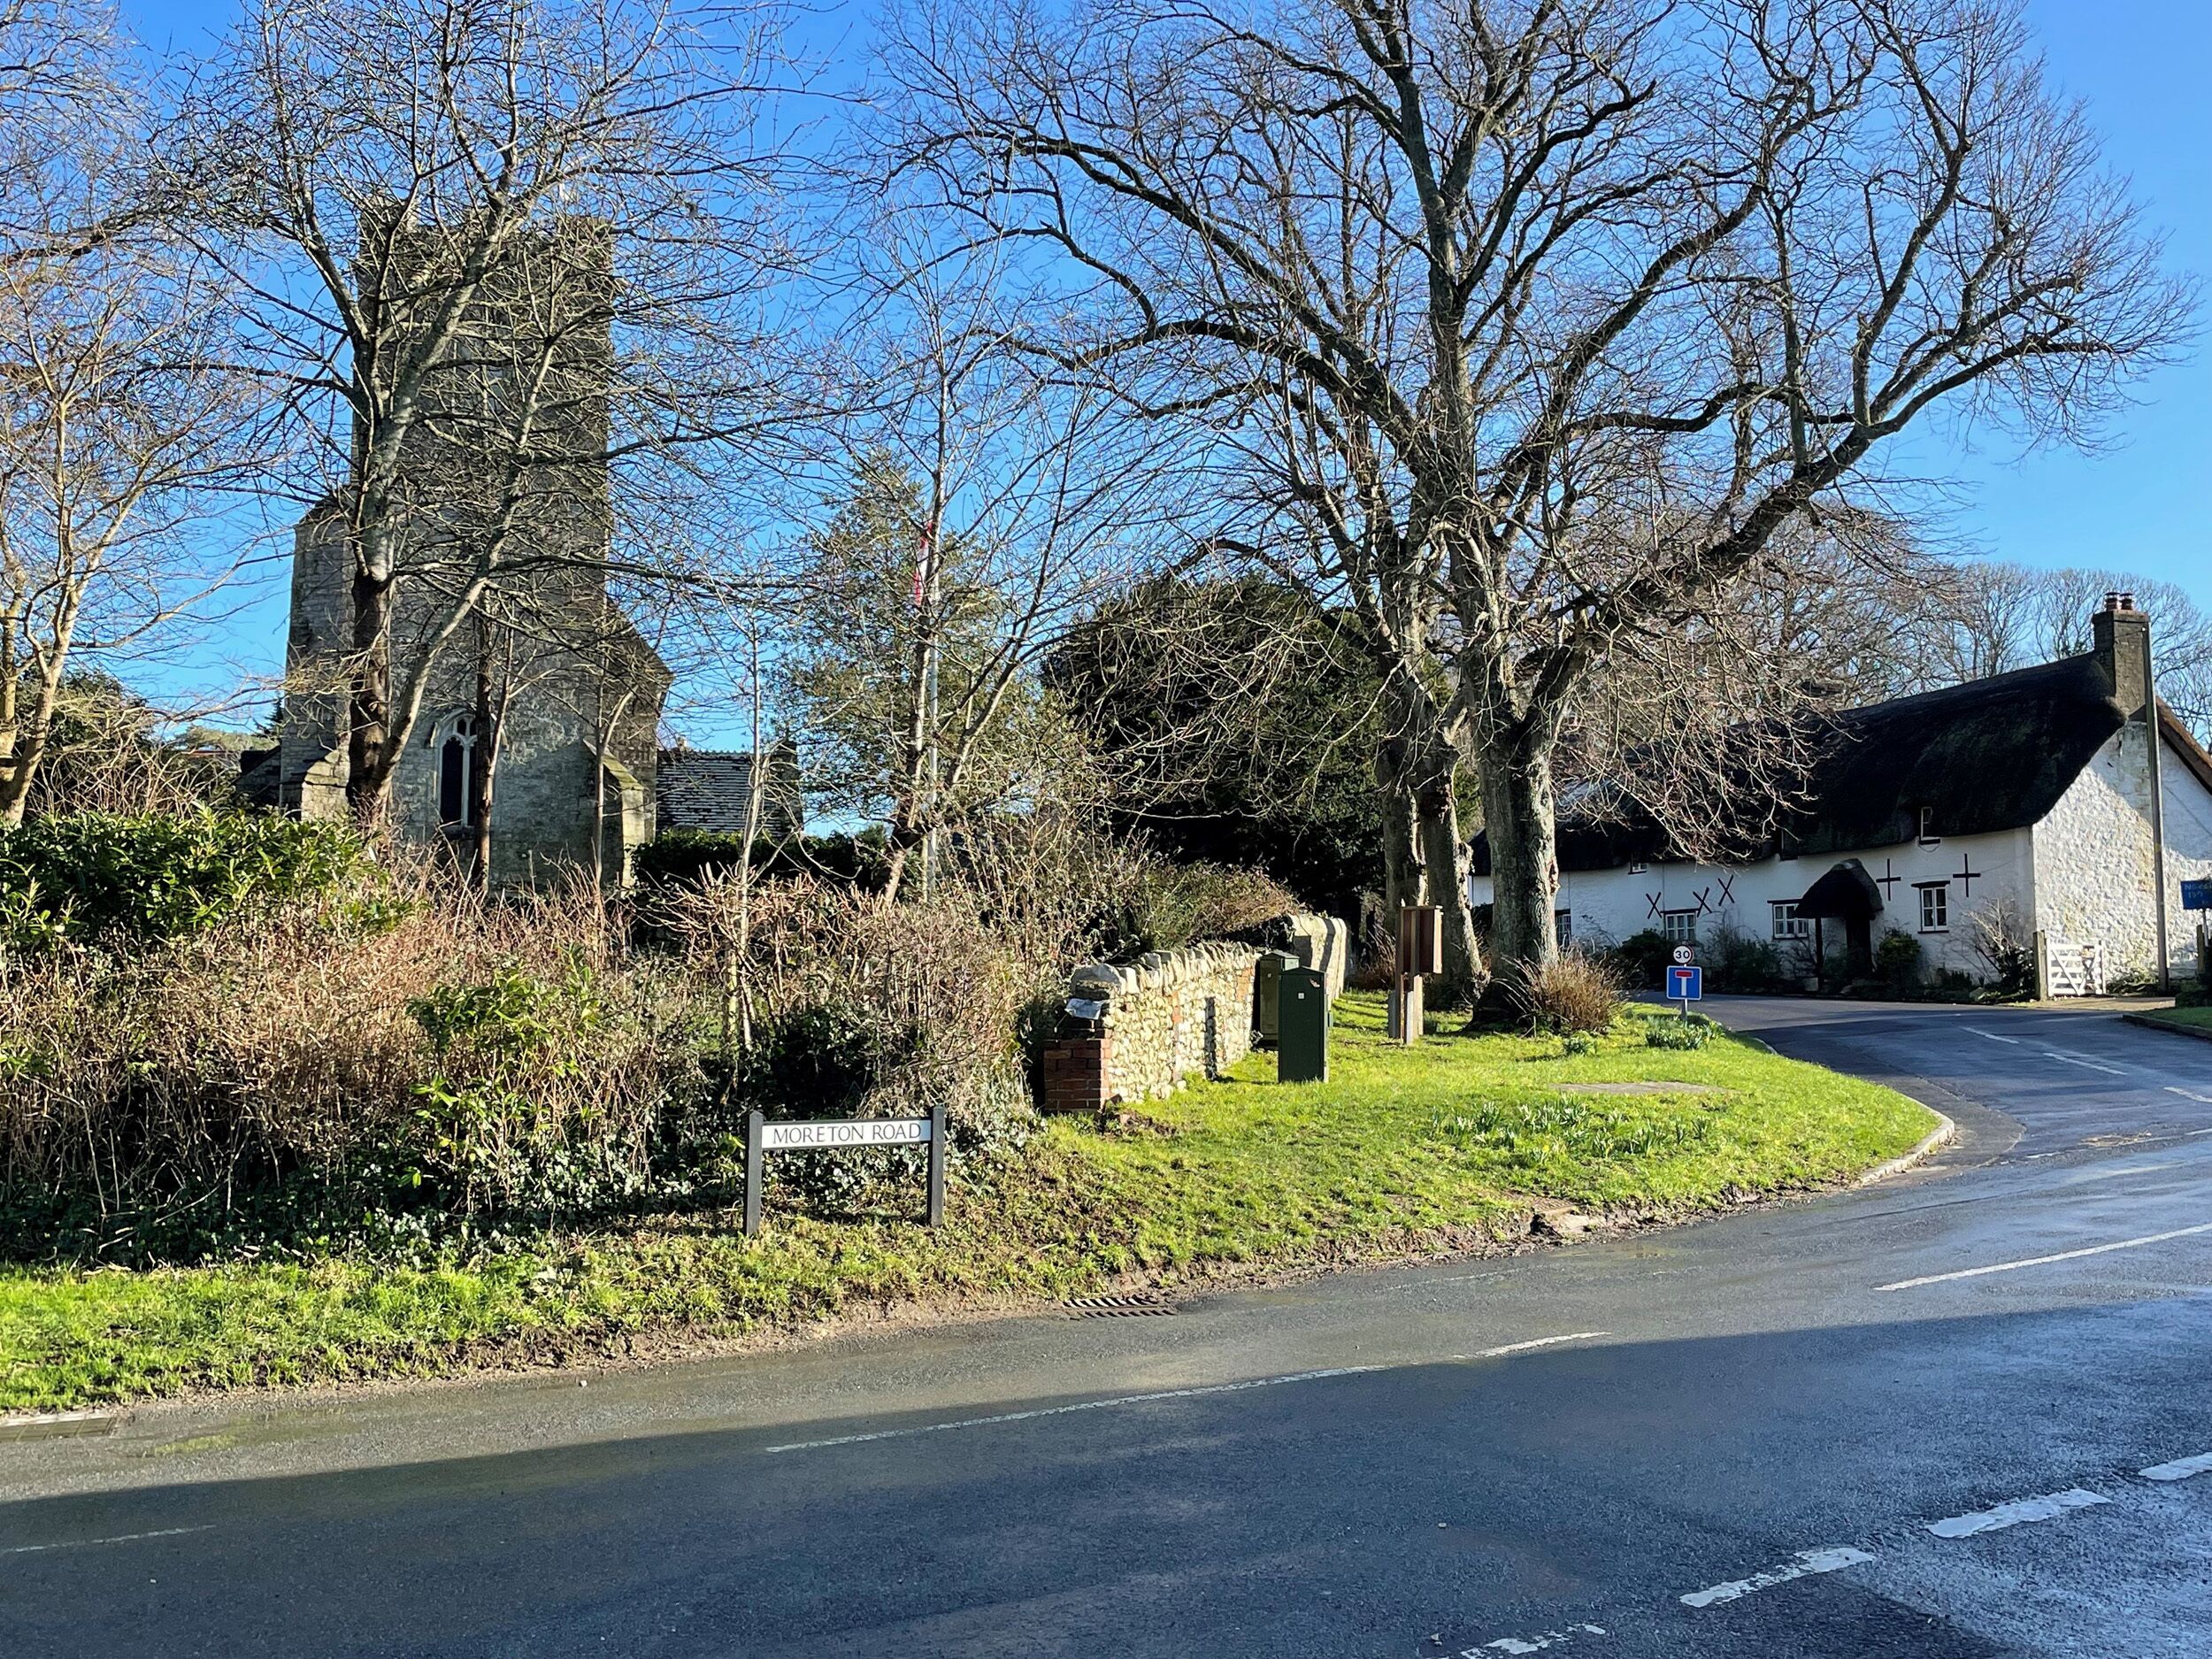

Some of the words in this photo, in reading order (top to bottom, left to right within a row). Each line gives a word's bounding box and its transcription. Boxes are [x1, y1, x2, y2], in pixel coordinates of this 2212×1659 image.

[1675, 950, 1691, 959] 30
[772, 1125, 864, 1144] MORETON
[872, 1123, 922, 1141] ROAD
